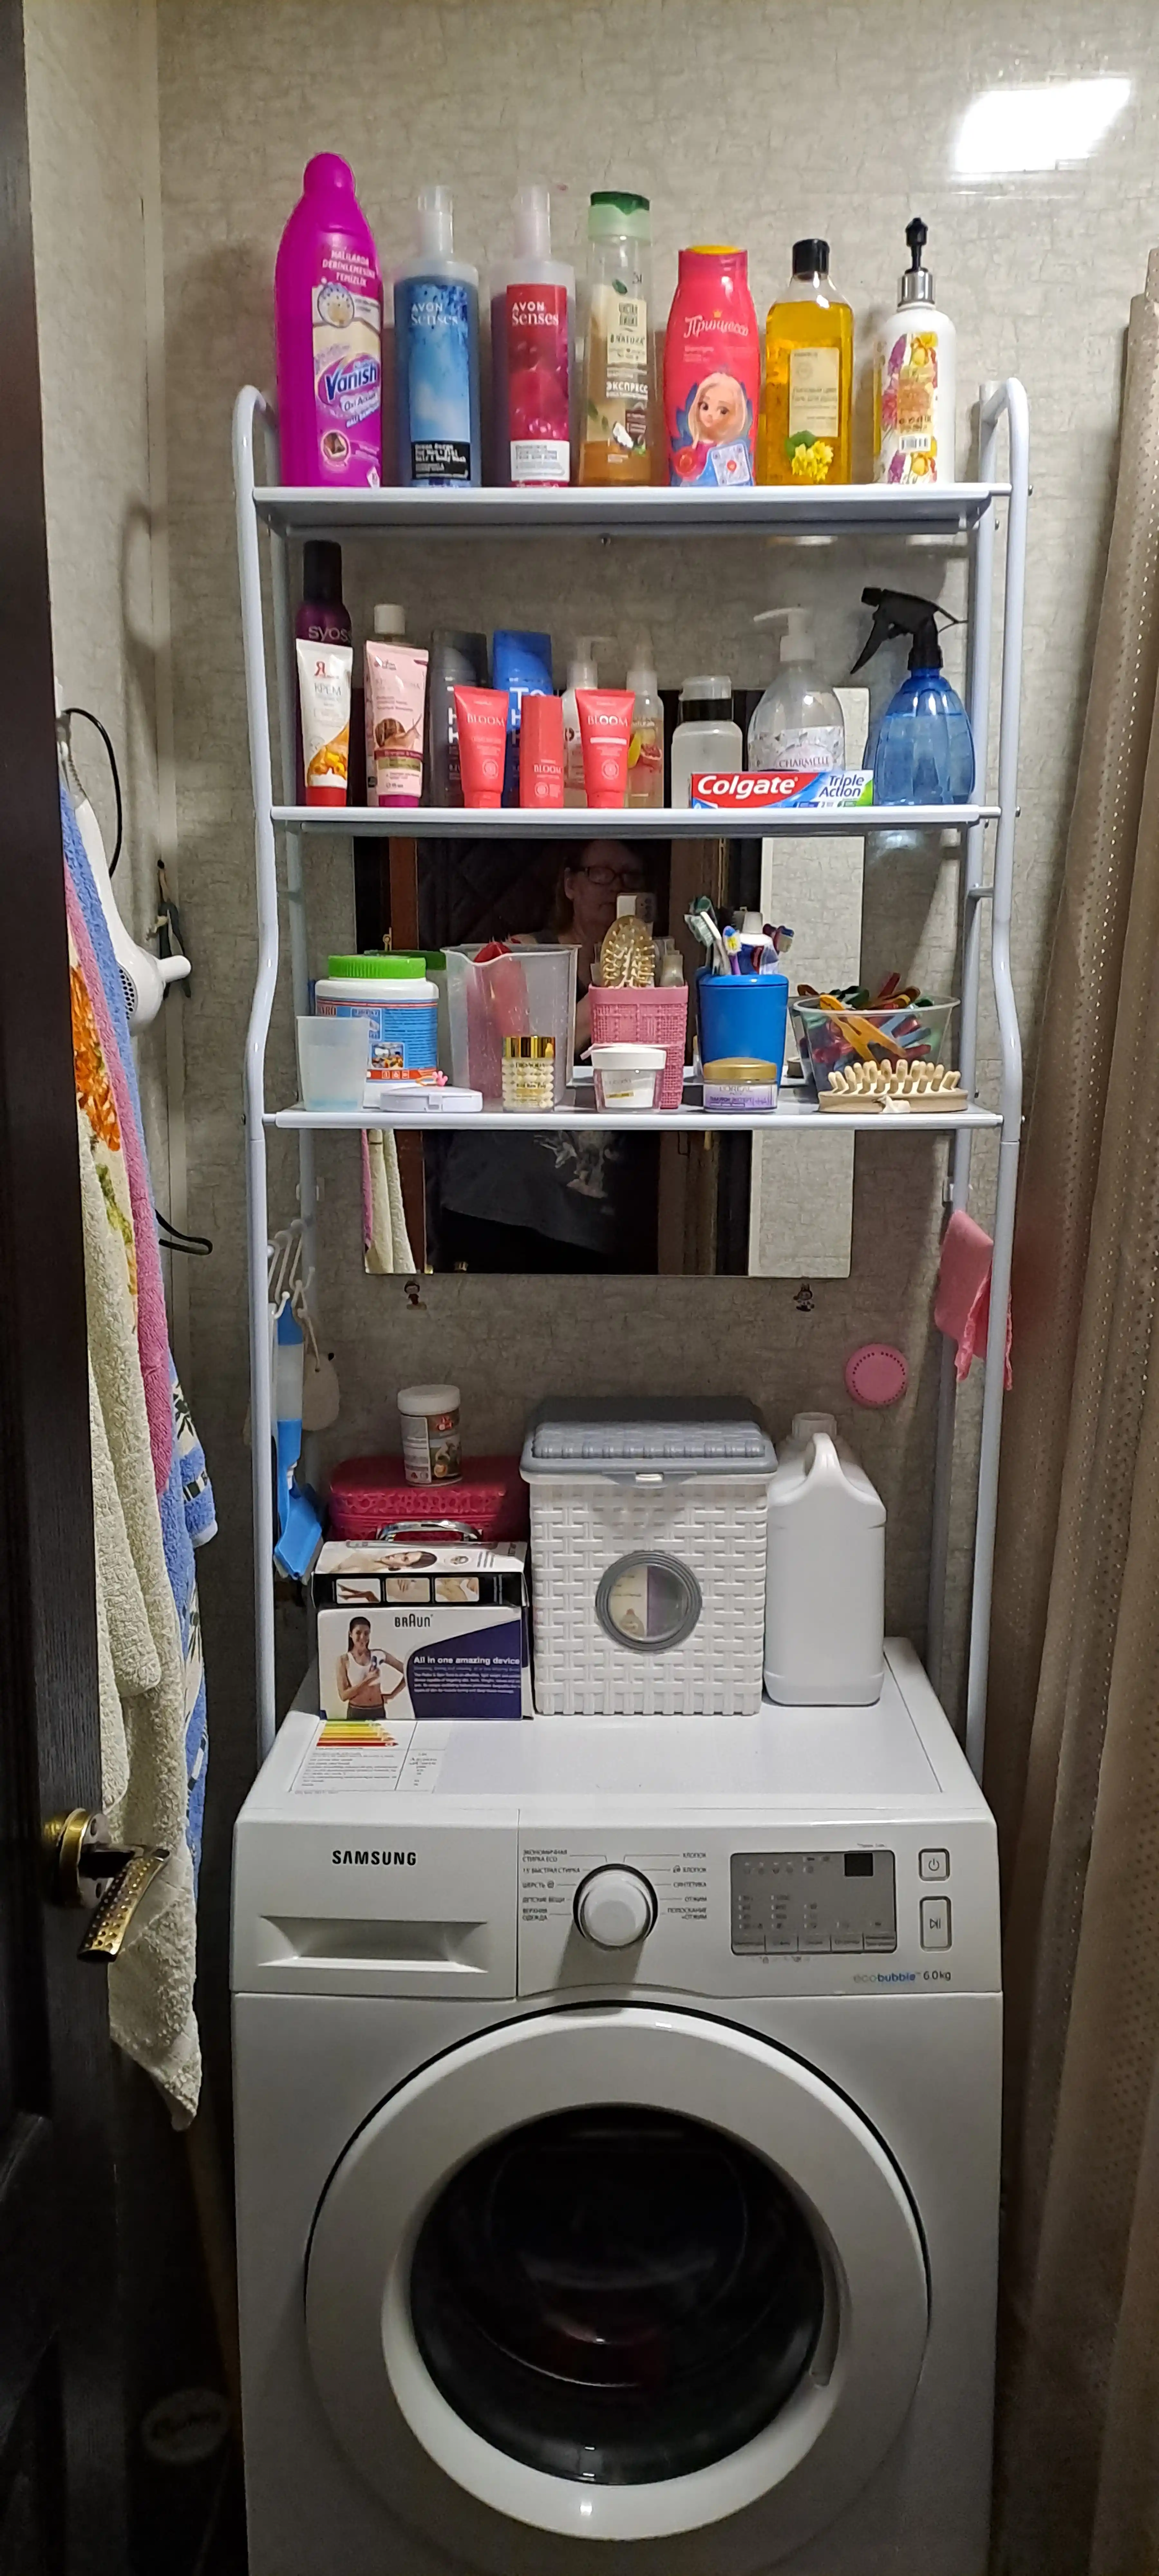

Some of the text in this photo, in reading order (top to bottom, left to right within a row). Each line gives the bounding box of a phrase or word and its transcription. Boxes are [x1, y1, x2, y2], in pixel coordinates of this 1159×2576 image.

[411, 302, 443, 312] AVON
[512, 301, 545, 312] AVON
[512, 311, 559, 327] Senses
[325, 363, 377, 401] Vanish
[308, 625, 352, 643] syos
[467, 713, 505, 727] BLOOM
[588, 715, 628, 727] BLOOM
[534, 764, 561, 774] BLOOM
[697, 775, 796, 800] Colgate
[829, 774, 864, 788] Triple
[818, 786, 861, 798] Action
[394, 1613, 430, 1627] BRAUN
[455, 1657, 491, 1665] amazing
[332, 1850, 416, 1866] SAMSUNG
